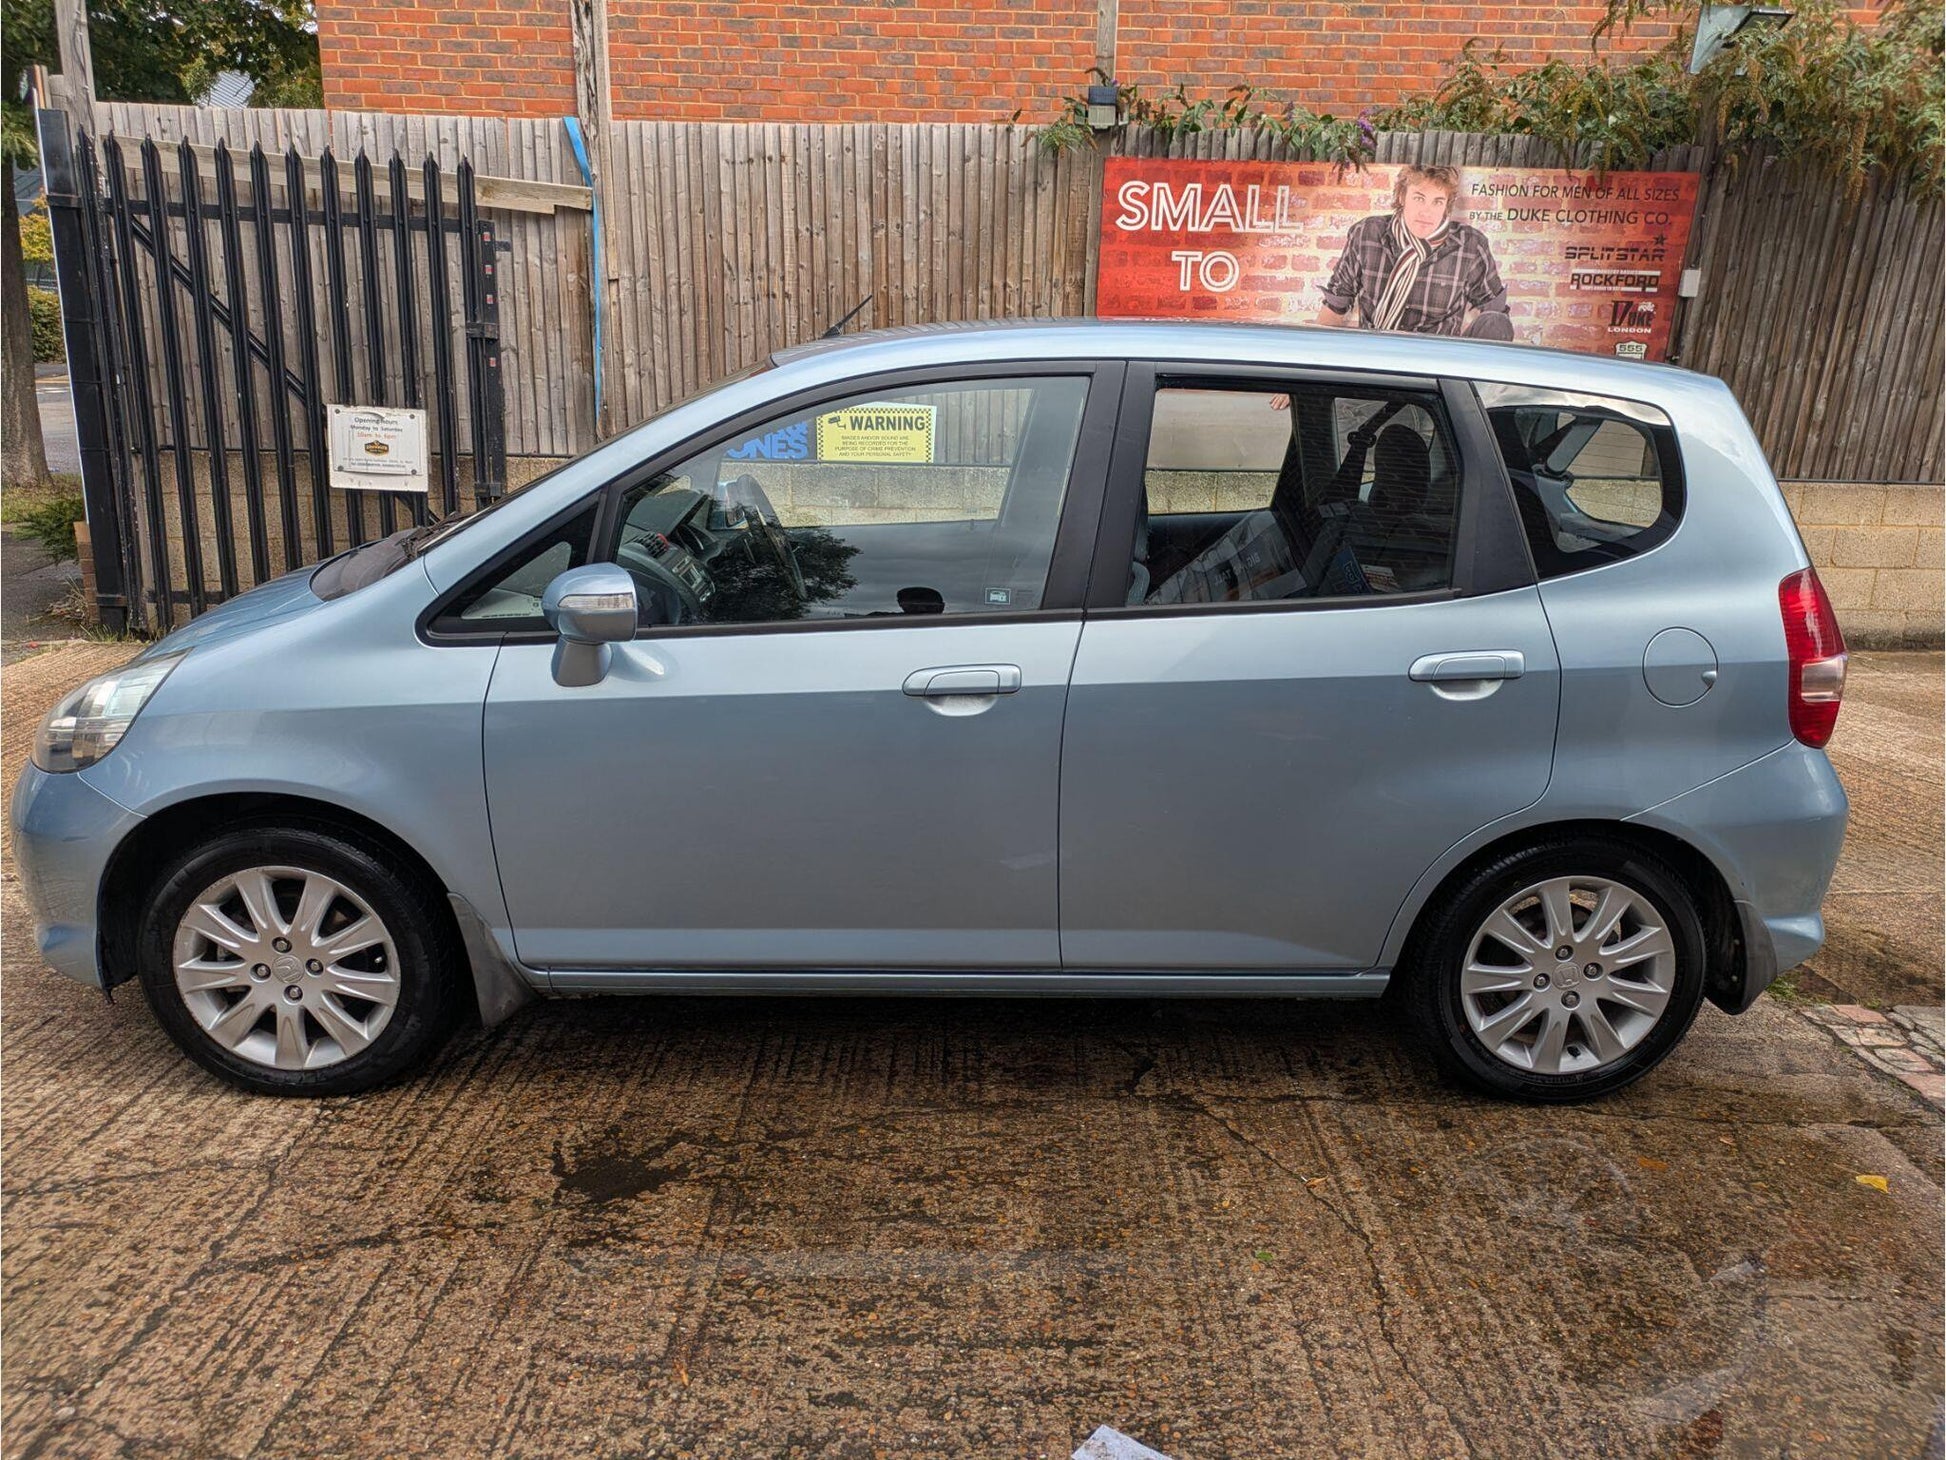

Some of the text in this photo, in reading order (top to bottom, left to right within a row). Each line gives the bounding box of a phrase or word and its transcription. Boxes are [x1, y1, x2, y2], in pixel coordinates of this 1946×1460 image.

[1471, 184, 1680, 202] FASHION FOR MEN OF ALL SIZES
[1115, 180, 1304, 233] SMALL
[1469, 208, 1672, 225] BY THE DUKE CLOTHING CO.
[1171, 250, 1240, 293] TO
[1570, 272, 1660, 292] ROCKFORD
[1618, 344, 1643, 352] 555
[354, 417, 380, 425] Opening
[849, 415, 926, 431] WARNING
